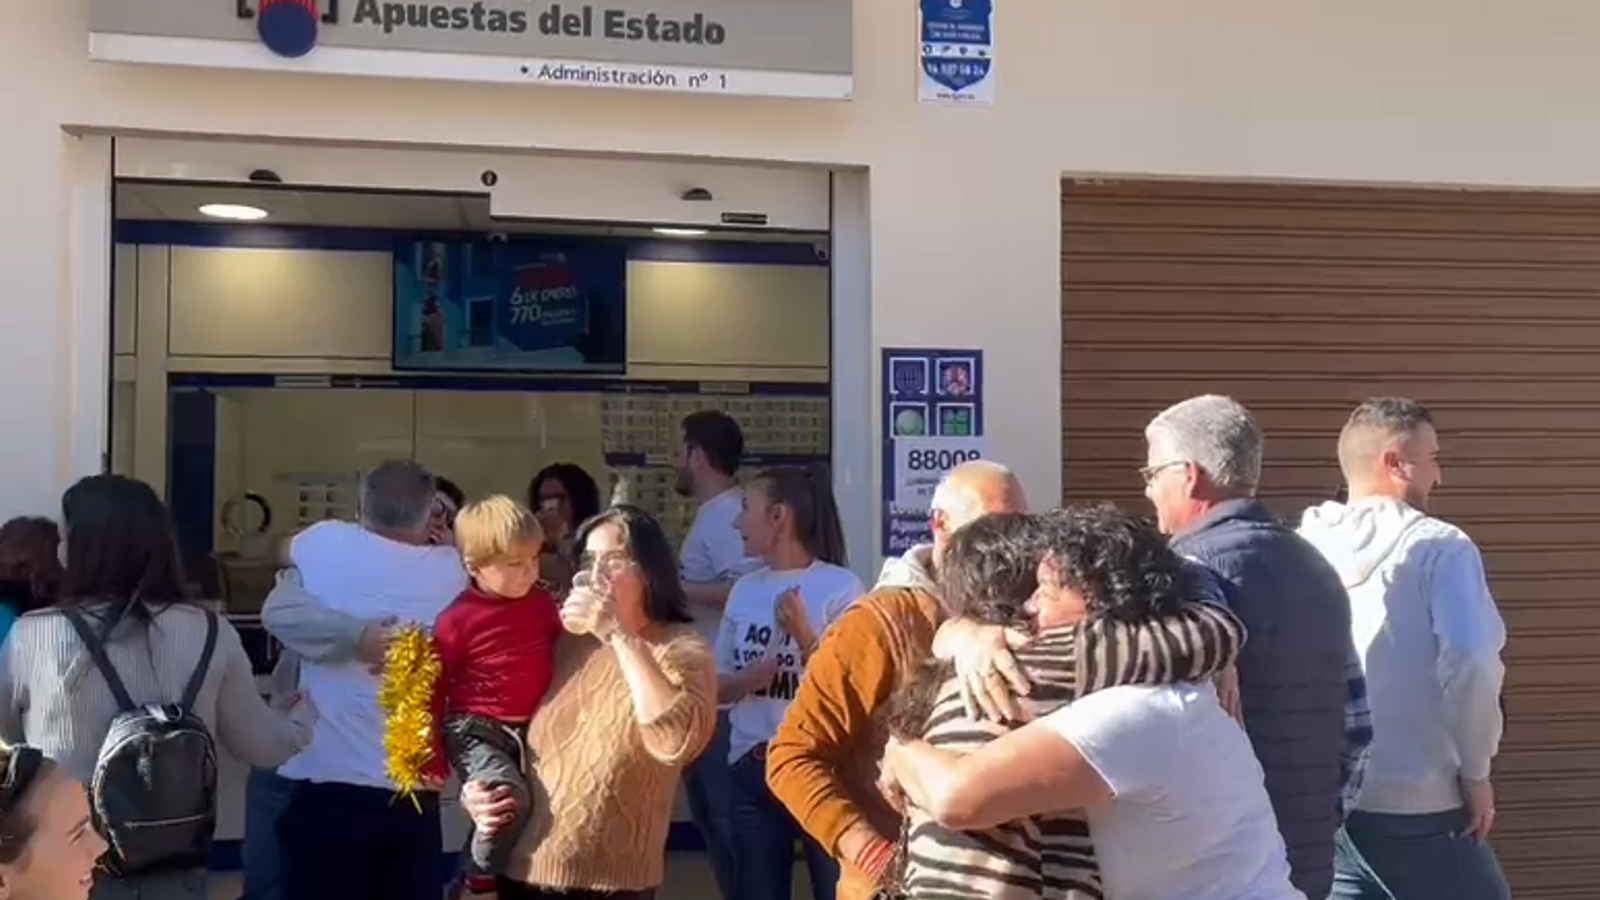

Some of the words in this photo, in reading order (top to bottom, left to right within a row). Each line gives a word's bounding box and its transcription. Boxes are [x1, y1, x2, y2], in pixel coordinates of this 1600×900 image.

[353, 0, 527, 33] Apuestas
[539, 4, 592, 36] del
[604, 10, 725, 45] Estado
[537, 64, 676, 86] Administración
[719, 74, 726, 88] 1
[509, 286, 523, 304] 6
[510, 303, 541, 325] 770
